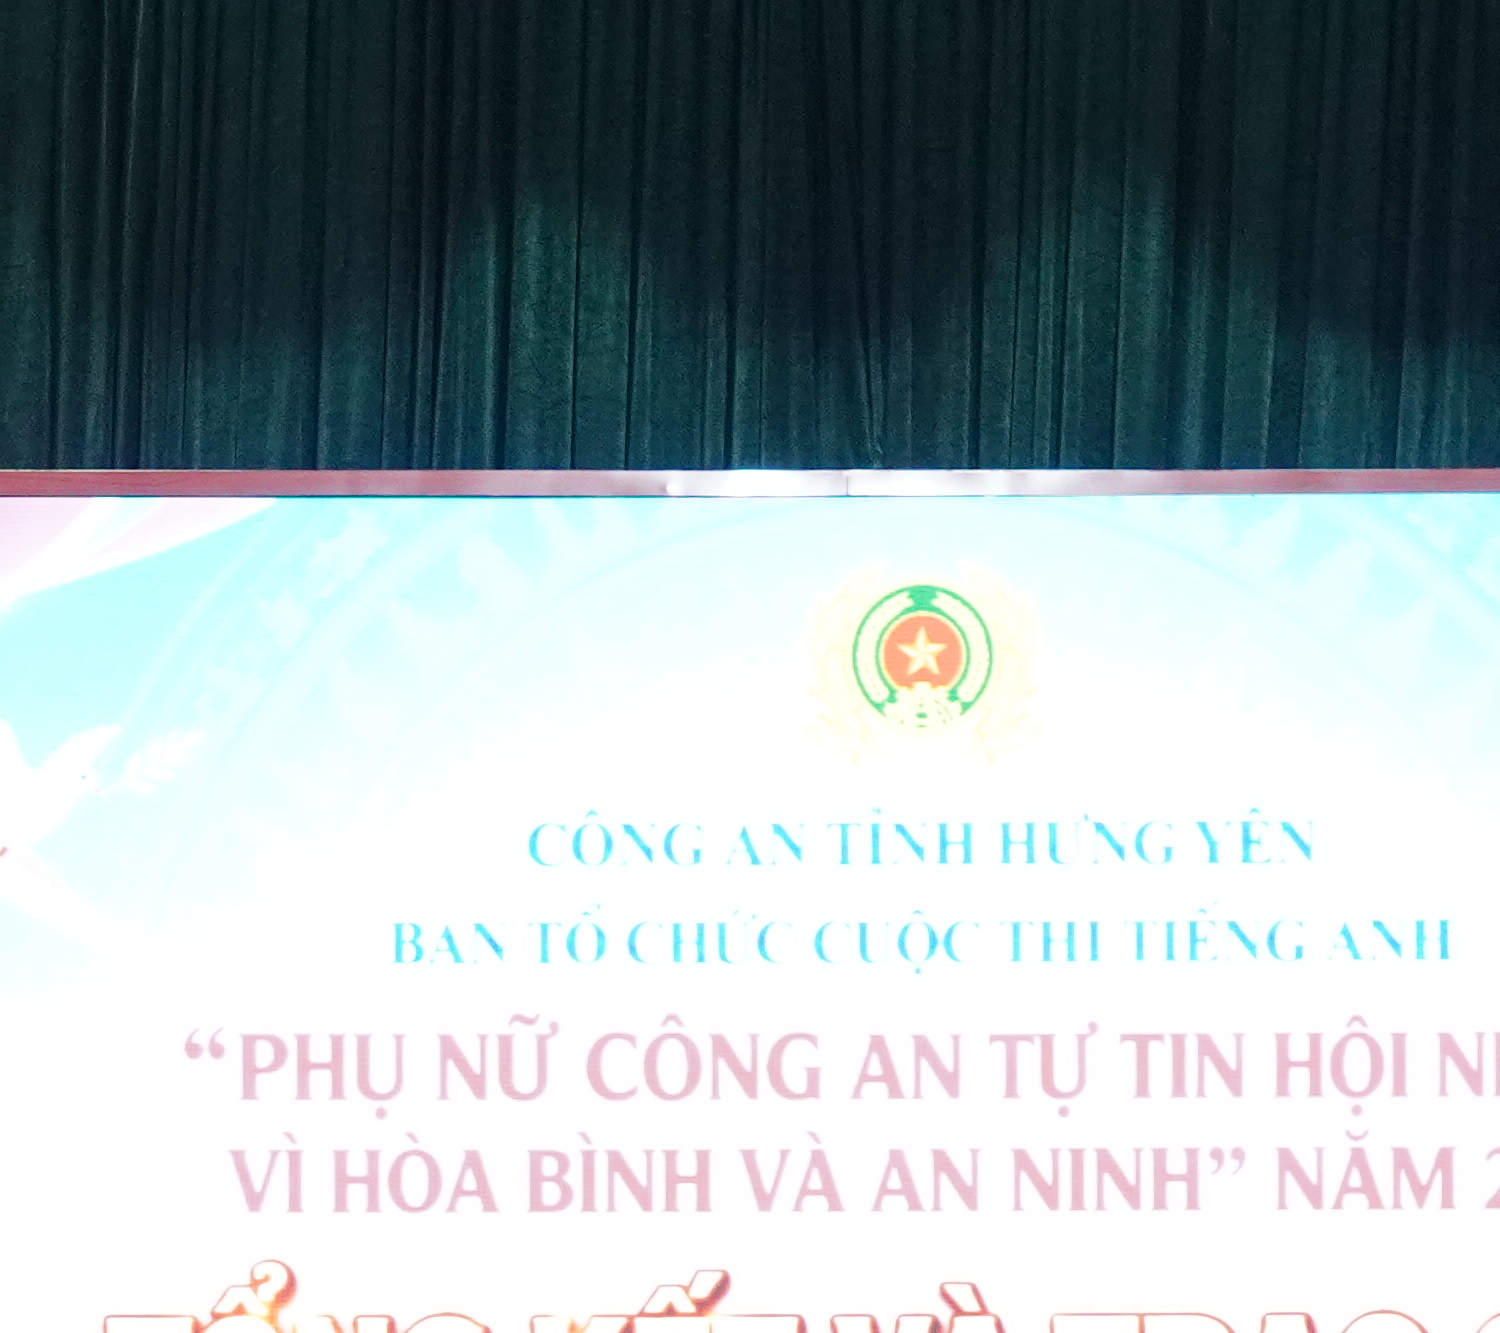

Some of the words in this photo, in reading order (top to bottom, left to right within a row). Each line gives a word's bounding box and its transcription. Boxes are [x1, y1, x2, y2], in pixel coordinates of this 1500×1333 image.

[527, 809, 705, 868] CÔNG
[726, 823, 806, 868] AN
[827, 806, 976, 868] TỈNH
[1000, 813, 1176, 867] HƯNG
[1195, 807, 1315, 866] YÊN
[393, 922, 506, 966] BAN
[528, 902, 610, 966] TỔ
[626, 910, 794, 966] CHỨC
[812, 909, 981, 977] CUỘC
[1000, 921, 1102, 964] THI
[1124, 902, 1306, 964] TIẾNG
[1329, 919, 1453, 963] ANH
[185, 1031, 406, 1121] “PHỤ
[439, 1014, 560, 1103] NỮ
[587, 1014, 822, 1103] CÔNG
[852, 1035, 962, 1101] AN
[990, 1022, 1099, 1119] TỰ
[1121, 1034, 1245, 1099] TIN
[1275, 1016, 1409, 1118] HỘI
[231, 1133, 304, 1214] VÌ
[334, 1133, 500, 1215] HÒA
[528, 1132, 713, 1214] BÌNH
[741, 1132, 846, 1213] VÀ
[872, 1149, 981, 1213] AN
[1012, 1147, 1247, 1213] NINH”
[1277, 1131, 1456, 1212] NĂM
